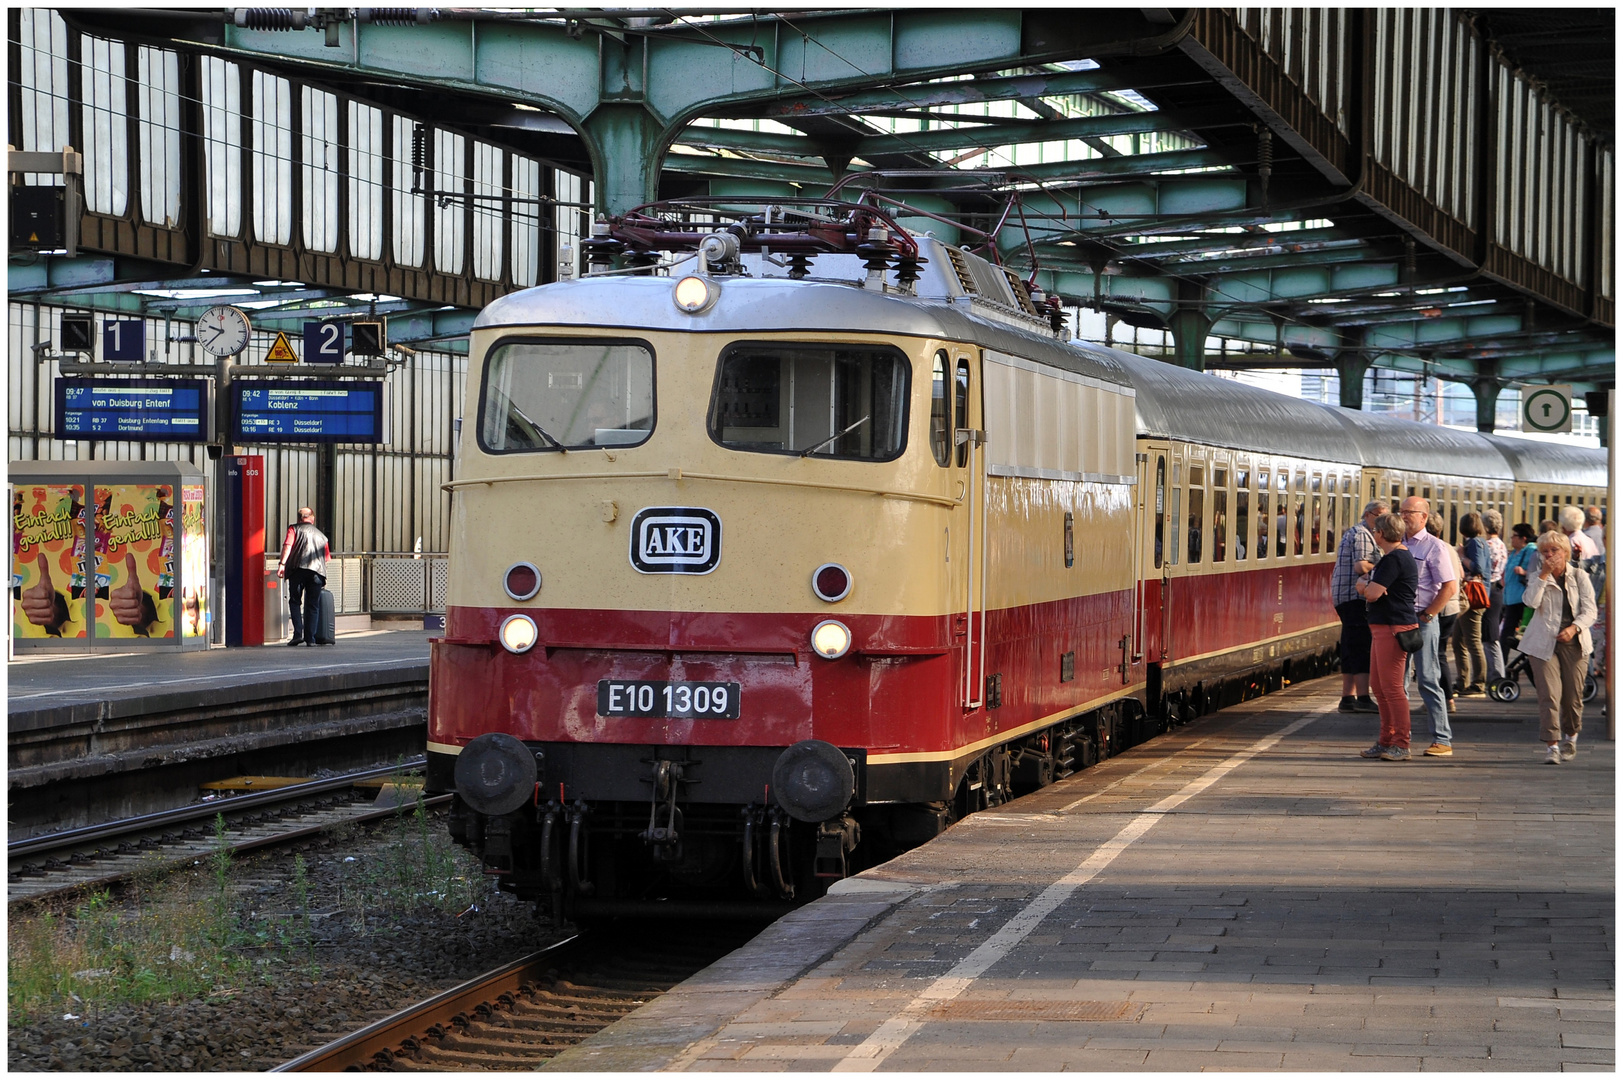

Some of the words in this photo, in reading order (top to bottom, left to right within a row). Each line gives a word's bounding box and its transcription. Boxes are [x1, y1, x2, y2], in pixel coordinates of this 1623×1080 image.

[108, 322, 120, 351] 1
[320, 324, 338, 354] 2
[110, 398, 142, 409] Duisburg
[146, 399, 170, 408] Entenf
[14, 507, 72, 530] Einfach
[102, 508, 160, 530] Einfach
[20, 520, 73, 552] genial!!!
[108, 521, 161, 552] genial!!!
[646, 527, 703, 554] AKE
[439, 617, 446, 628] 3
[609, 684, 654, 712] E10
[663, 686, 728, 714] 1309
